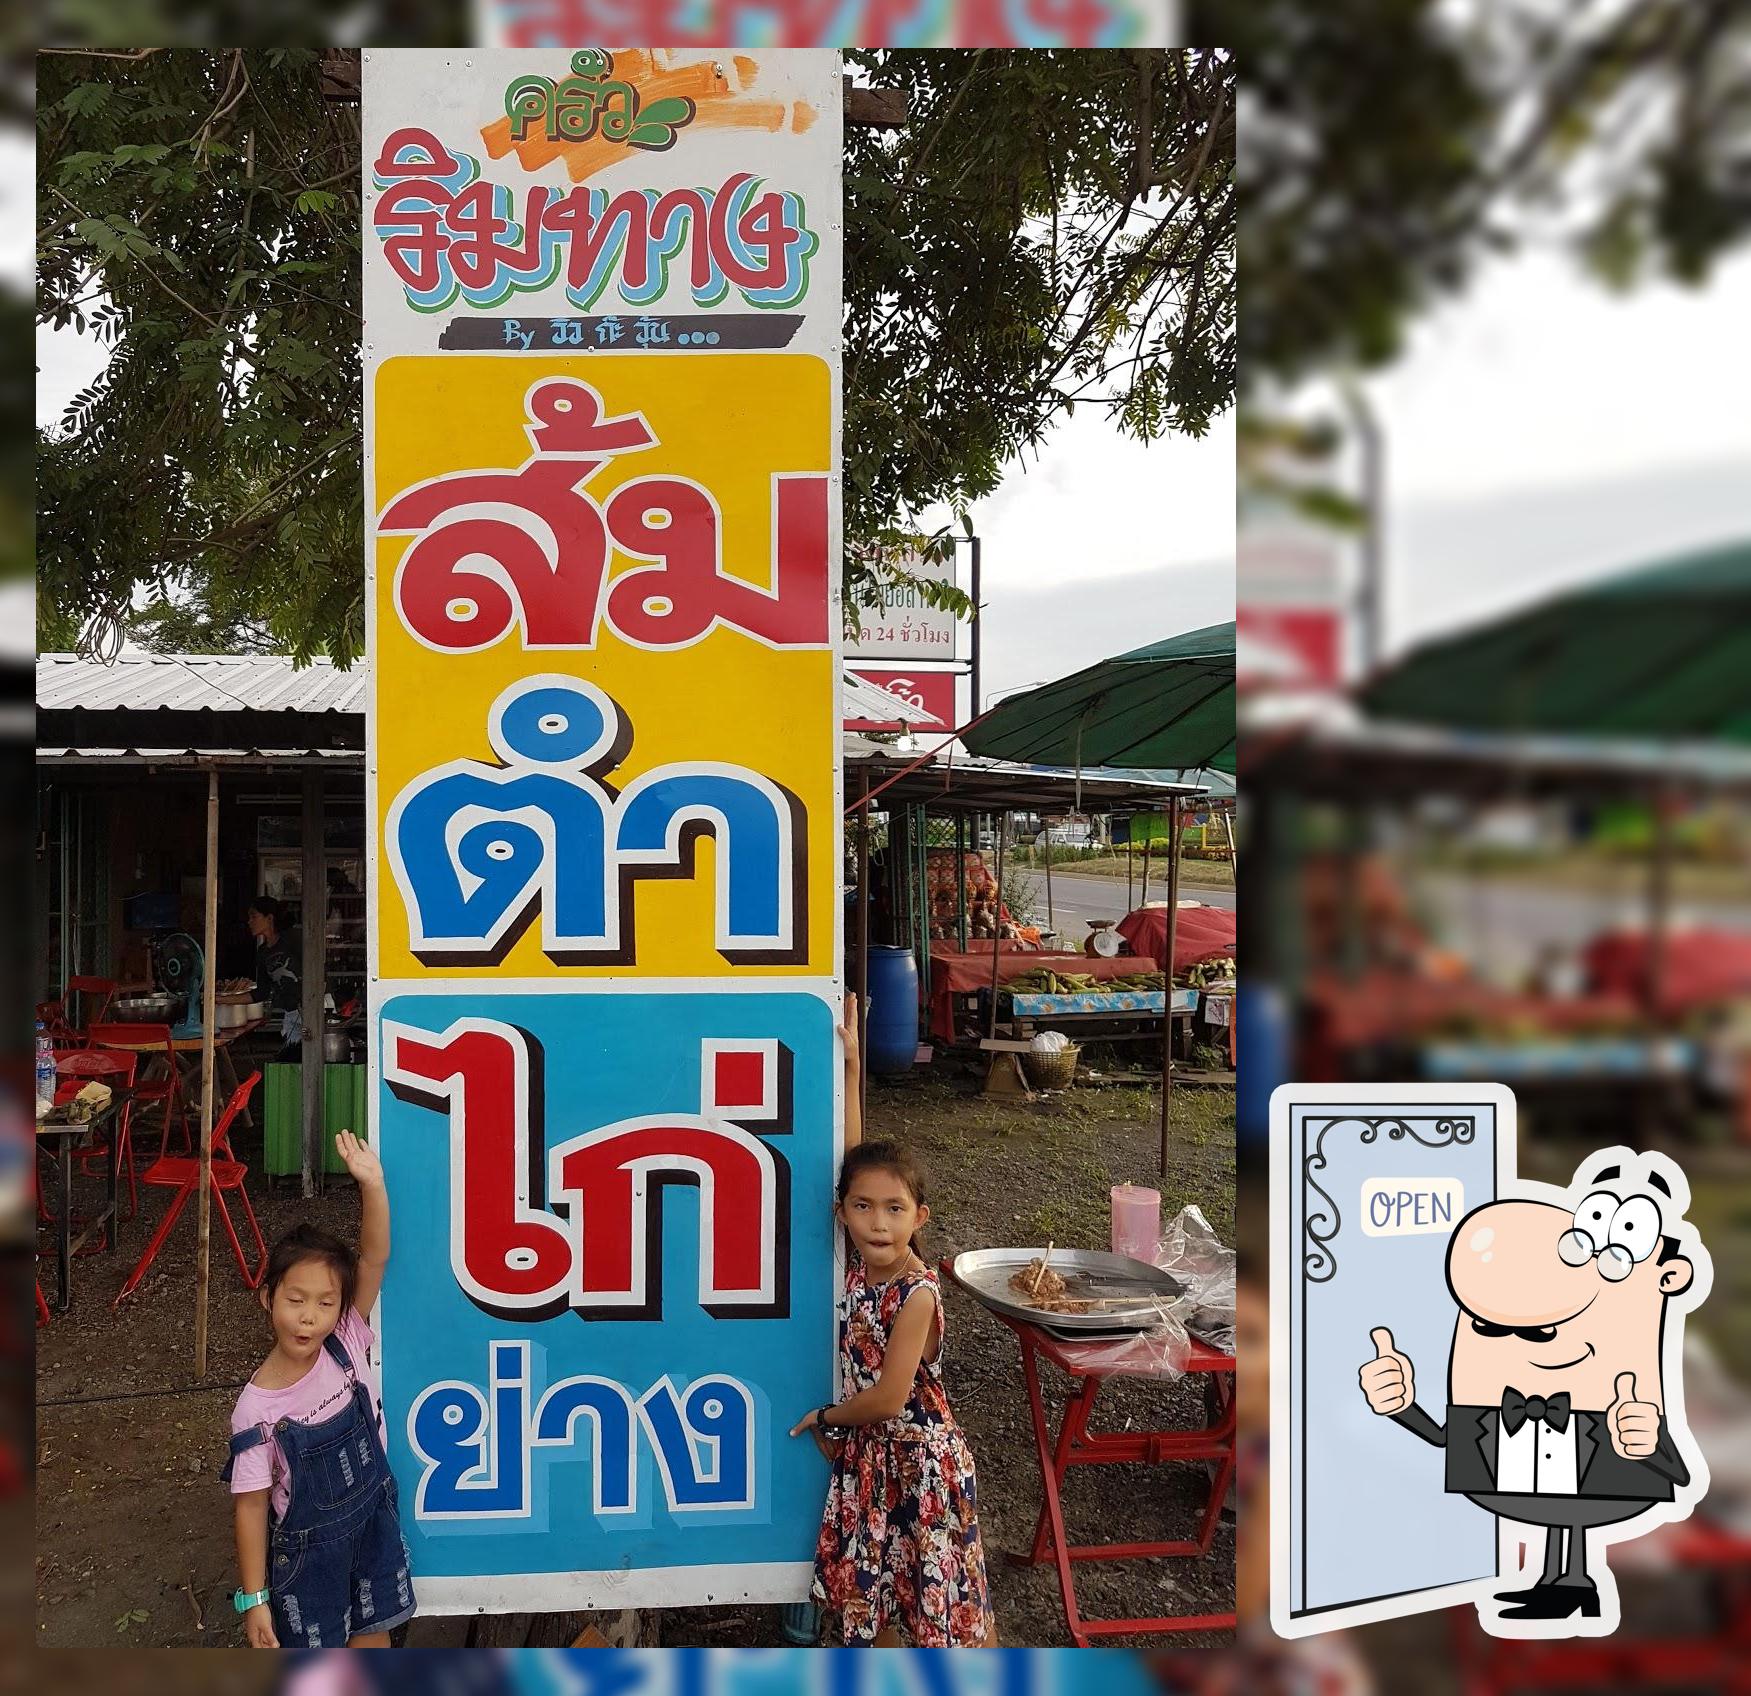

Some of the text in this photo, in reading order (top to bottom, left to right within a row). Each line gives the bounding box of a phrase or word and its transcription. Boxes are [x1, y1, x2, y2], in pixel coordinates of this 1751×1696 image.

[504, 48, 640, 143] ครัว
[372, 127, 818, 312] ริมทาง
[503, 319, 536, 351] By
[377, 376, 831, 653] ส้ม
[876, 627, 894, 642] 24
[900, 616, 950, 643] ชั่วโมง
[385, 673, 800, 958] ตำ
[382, 1017, 785, 1315] ไก่
[407, 1339, 758, 1521] ย่าง
